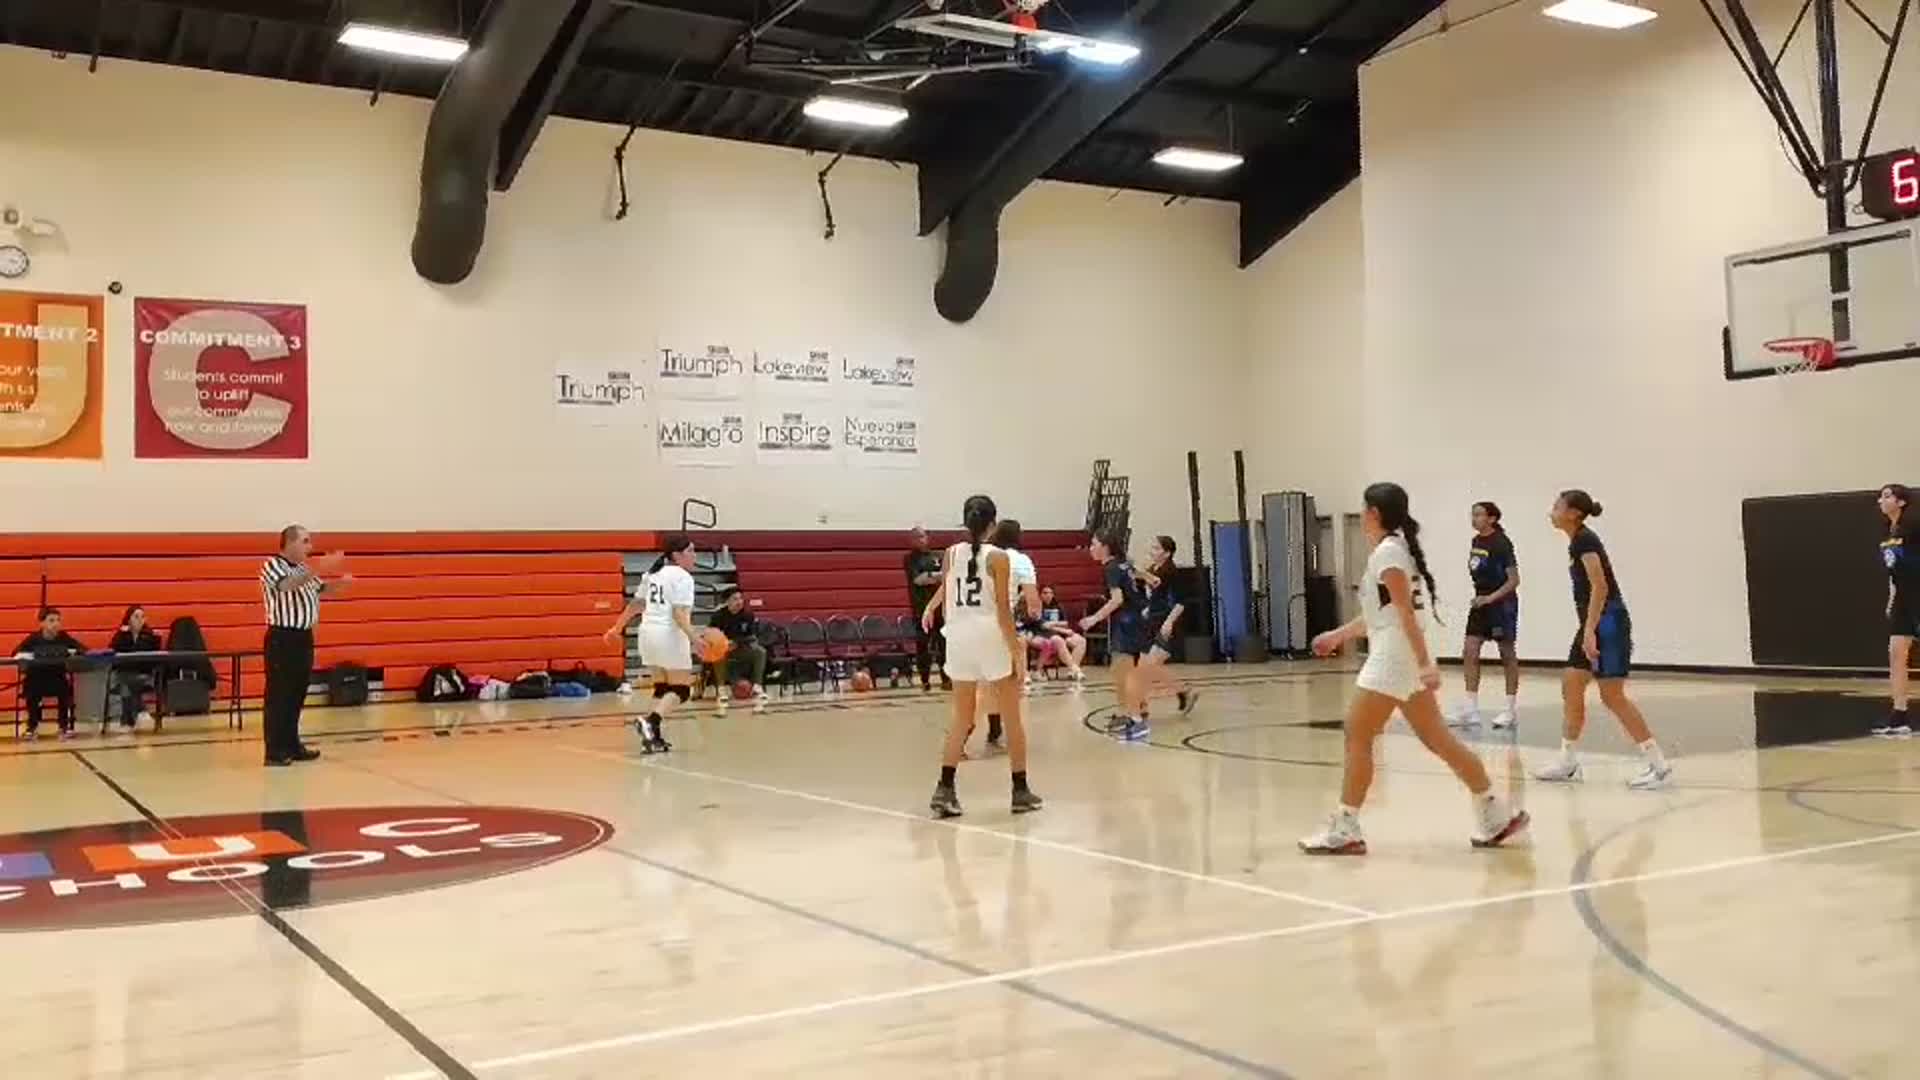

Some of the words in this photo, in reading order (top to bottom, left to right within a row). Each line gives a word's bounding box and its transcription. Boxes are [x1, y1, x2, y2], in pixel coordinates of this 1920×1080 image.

[87, 327, 97, 343] 2
[139, 329, 284, 350] COMMITMENT
[289, 335, 302, 350] 3
[660, 349, 743, 375] Triumph
[753, 352, 828, 376] Lakeview
[843, 357, 914, 383] Lakeview
[229, 371, 284, 385] commit
[556, 373, 646, 404] Triumph
[213, 388, 249, 402] uplift
[759, 421, 832, 448] Inspire
[956, 577, 982, 606] 12
[0, 832, 562, 899] HOOLS
